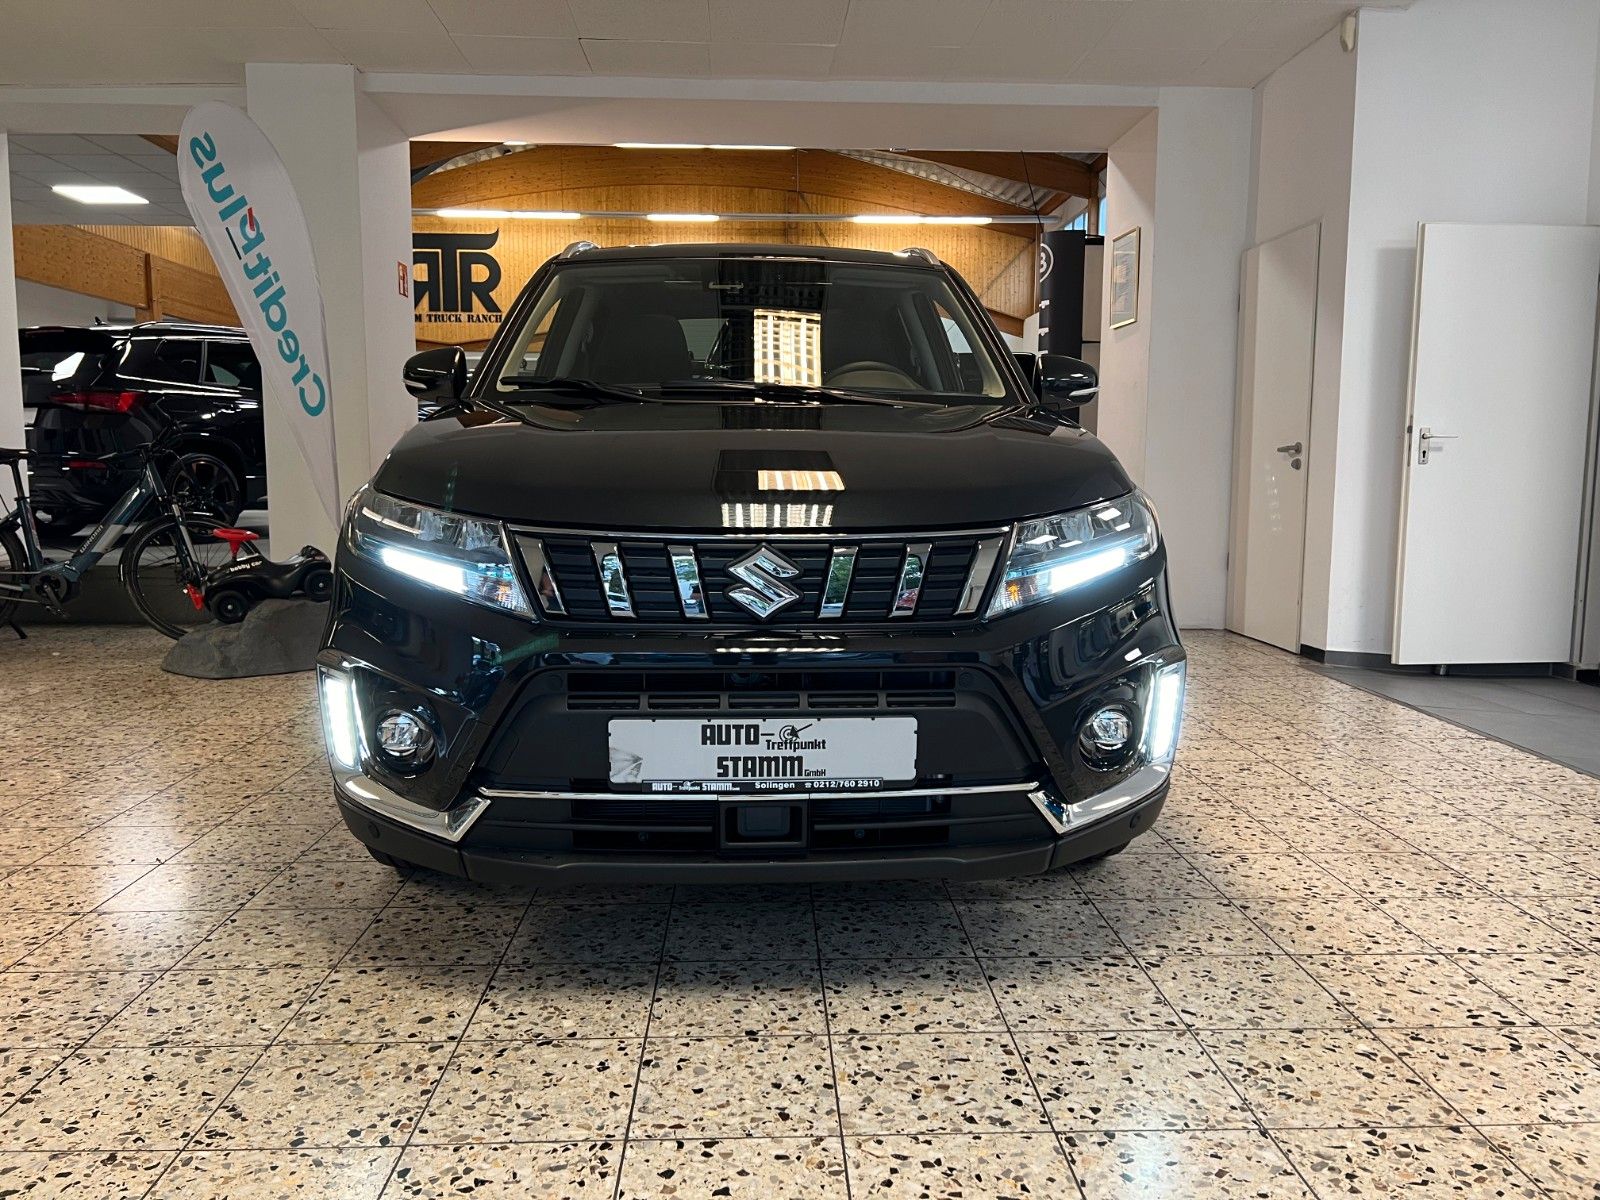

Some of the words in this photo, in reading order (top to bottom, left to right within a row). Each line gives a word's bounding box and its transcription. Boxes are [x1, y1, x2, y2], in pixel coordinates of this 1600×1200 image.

[426, 313, 462, 323] TRUCK
[467, 314, 503, 323] RANCH
[229, 563, 251, 572] bobby
[765, 739, 827, 752] Treffpunkt
[716, 756, 804, 778] STAMM
[804, 769, 827, 777] GmbH
[754, 781, 796, 790] Solingen
[813, 780, 856, 788] 0212/760
